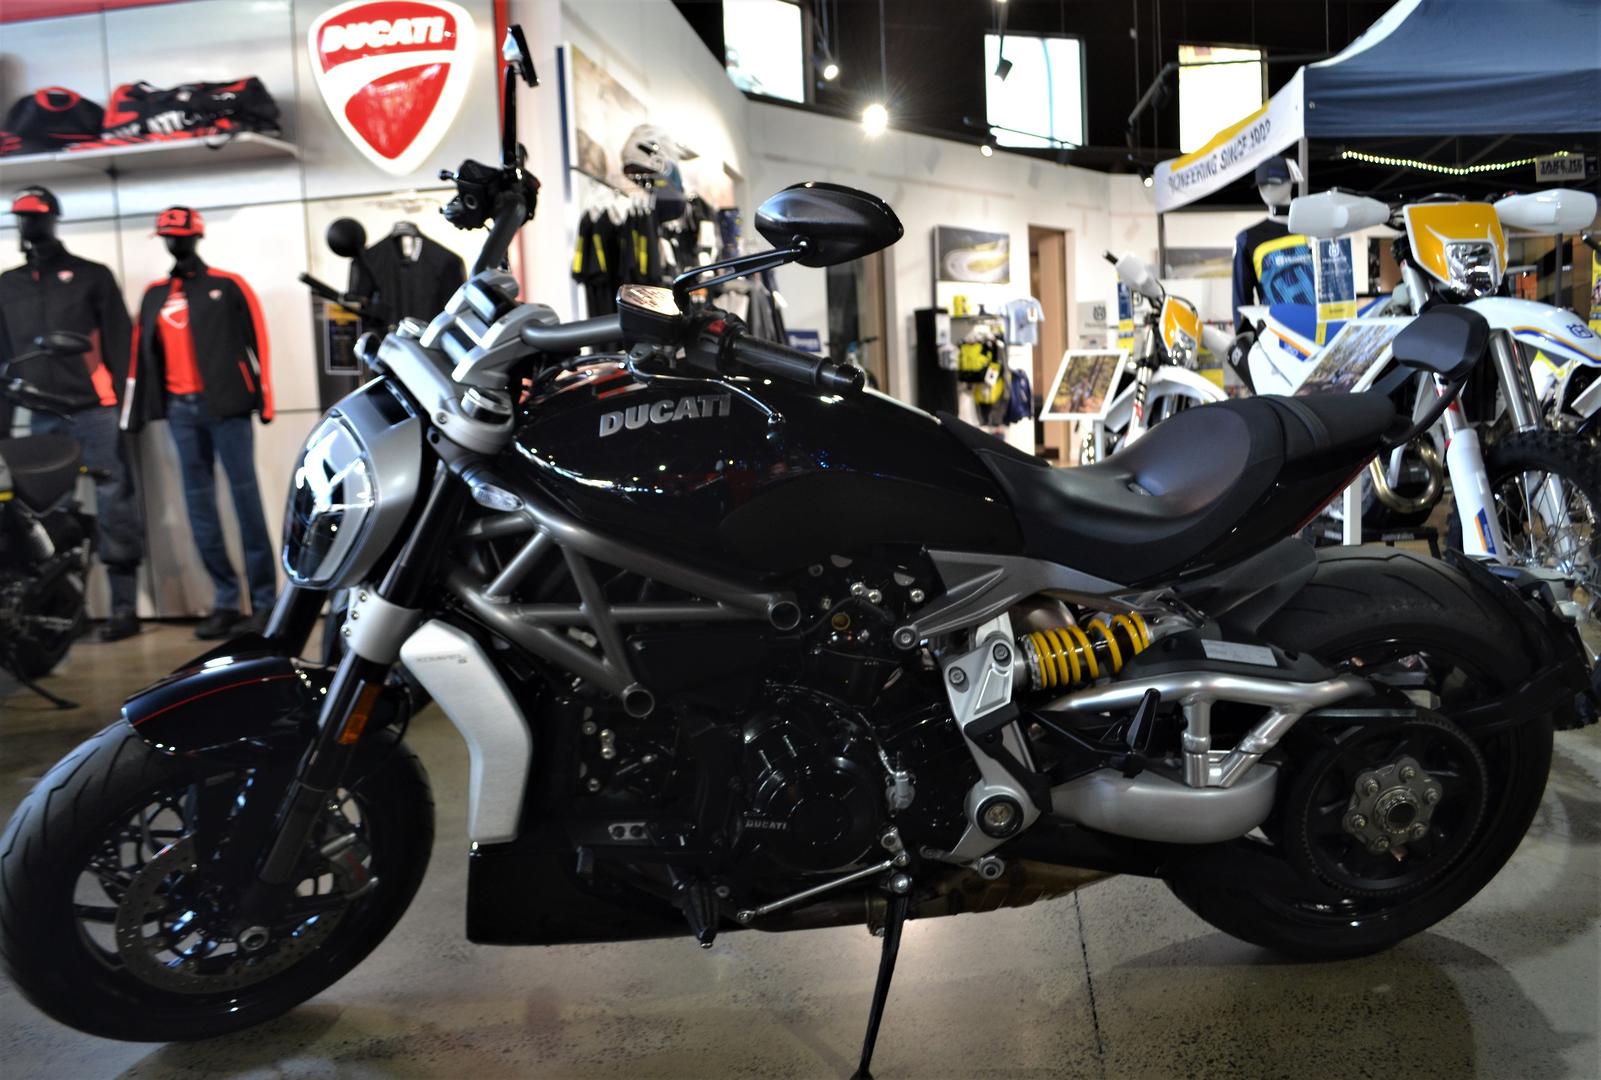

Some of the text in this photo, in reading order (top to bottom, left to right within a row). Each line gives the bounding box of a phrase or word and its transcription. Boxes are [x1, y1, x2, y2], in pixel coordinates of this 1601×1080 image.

[320, 16, 446, 53] DUCATI
[599, 393, 732, 437] DUCATI
[745, 820, 787, 830] DUCATI
